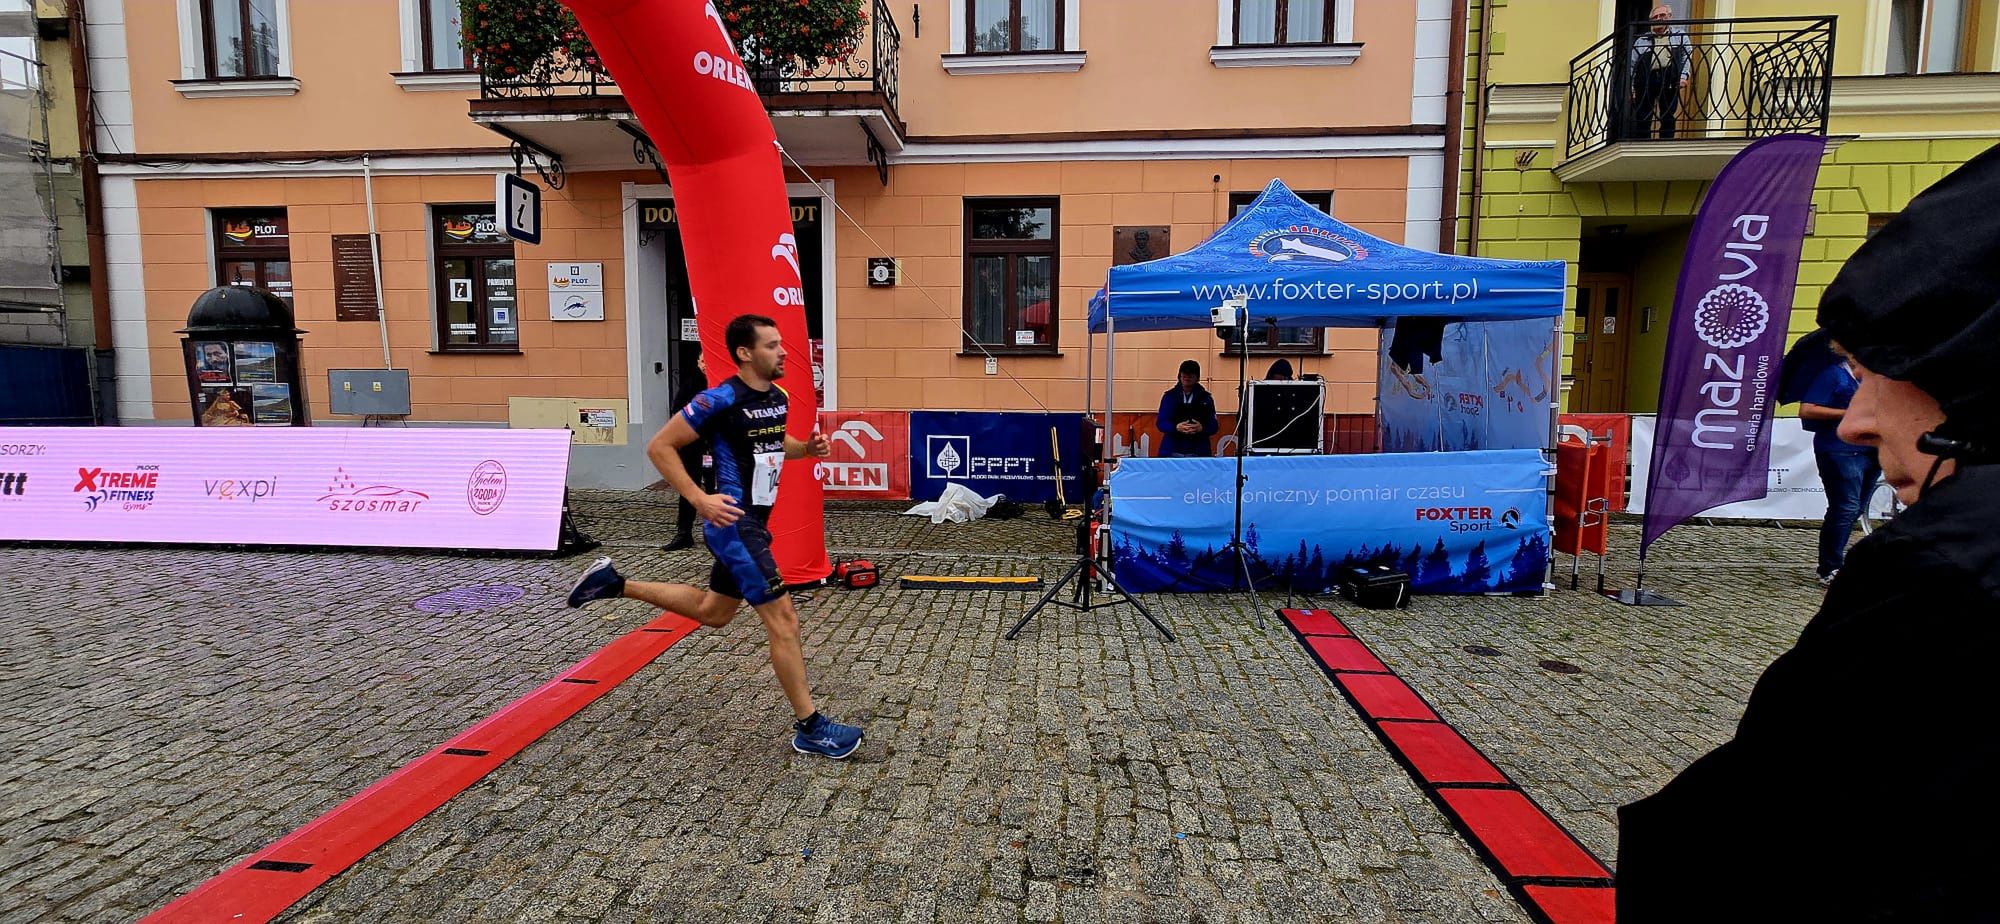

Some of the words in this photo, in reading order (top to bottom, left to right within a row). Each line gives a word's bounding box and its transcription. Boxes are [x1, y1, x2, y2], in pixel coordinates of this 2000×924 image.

[693, 51, 755, 93] ORLEN
[254, 226, 277, 234] PLOT
[773, 287, 804, 306] ORL
[1192, 279, 1478, 304] www.foxter-sport.pl
[1752, 355, 1769, 411] handlowa
[1746, 409, 1763, 452] galeria
[0, 444, 46, 455] SORZY:
[971, 457, 1035, 472] PPPT
[74, 467, 158, 492] XTREME
[822, 467, 882, 486] RLEN
[109, 490, 154, 501] FITNESS
[205, 476, 277, 502] vexpi
[1184, 486, 1321, 506] elektoniczny
[1326, 484, 1400, 506] pomiar
[1406, 485, 1465, 501] czasu
[329, 499, 421, 513] szosmar
[1416, 508, 1492, 520] FOXTER
[1450, 521, 1491, 534] Sport
